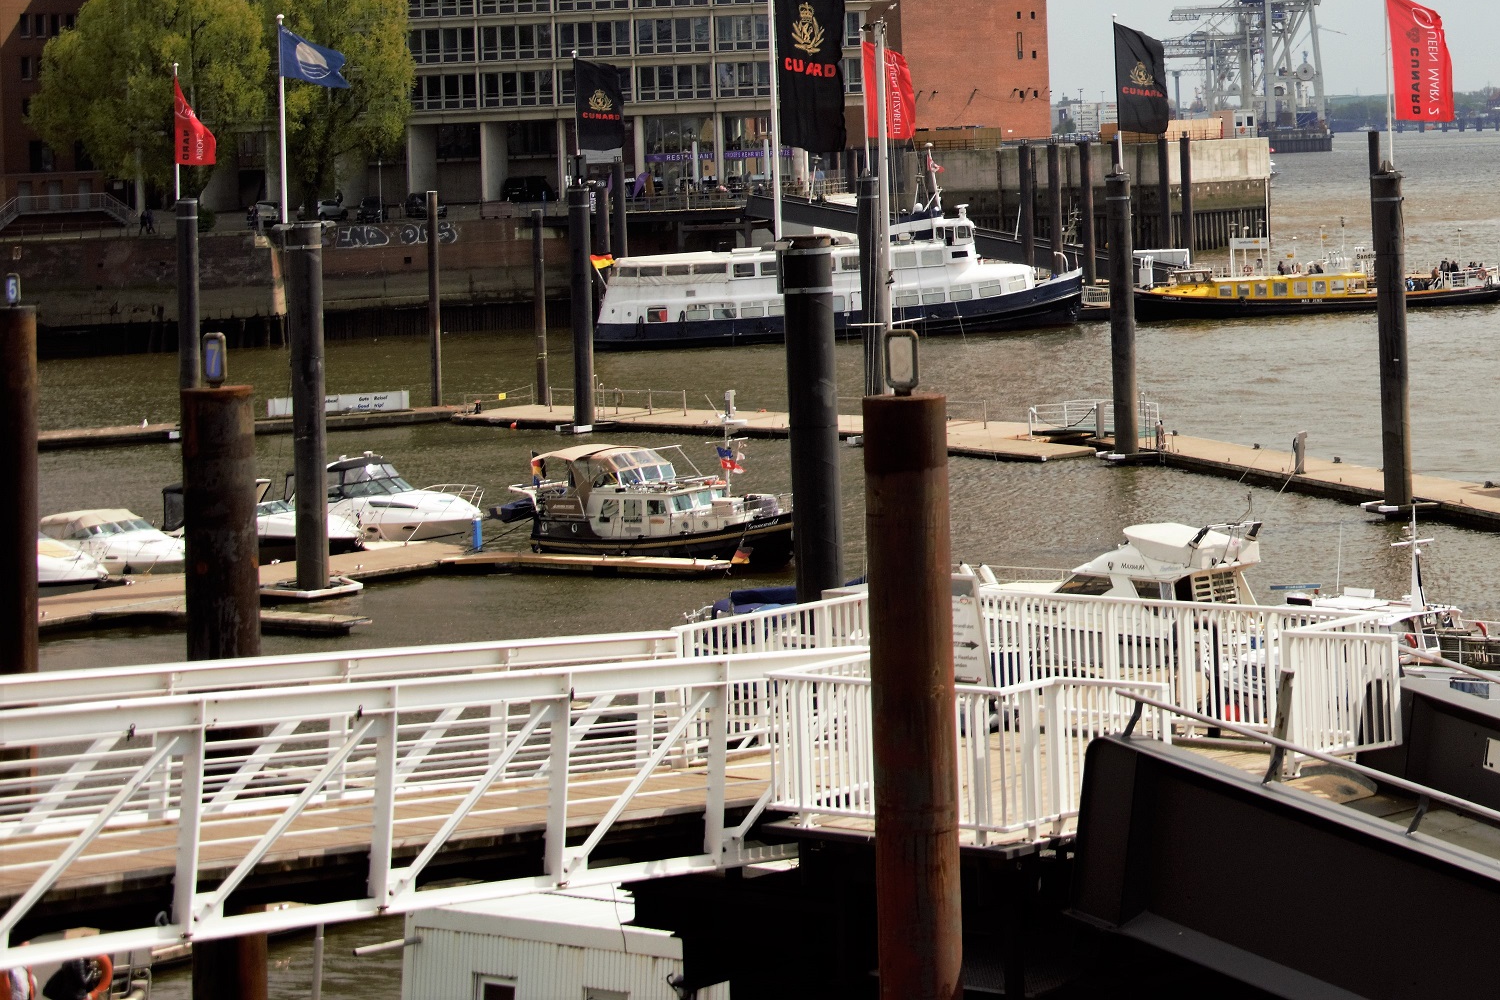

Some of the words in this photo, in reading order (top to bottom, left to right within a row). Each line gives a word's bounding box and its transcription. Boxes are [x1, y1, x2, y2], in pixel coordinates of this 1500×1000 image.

[784, 57, 837, 78] CUARD
[582, 111, 620, 121] CUNARD
[9, 279, 17, 300] 5
[207, 343, 220, 375] 7
